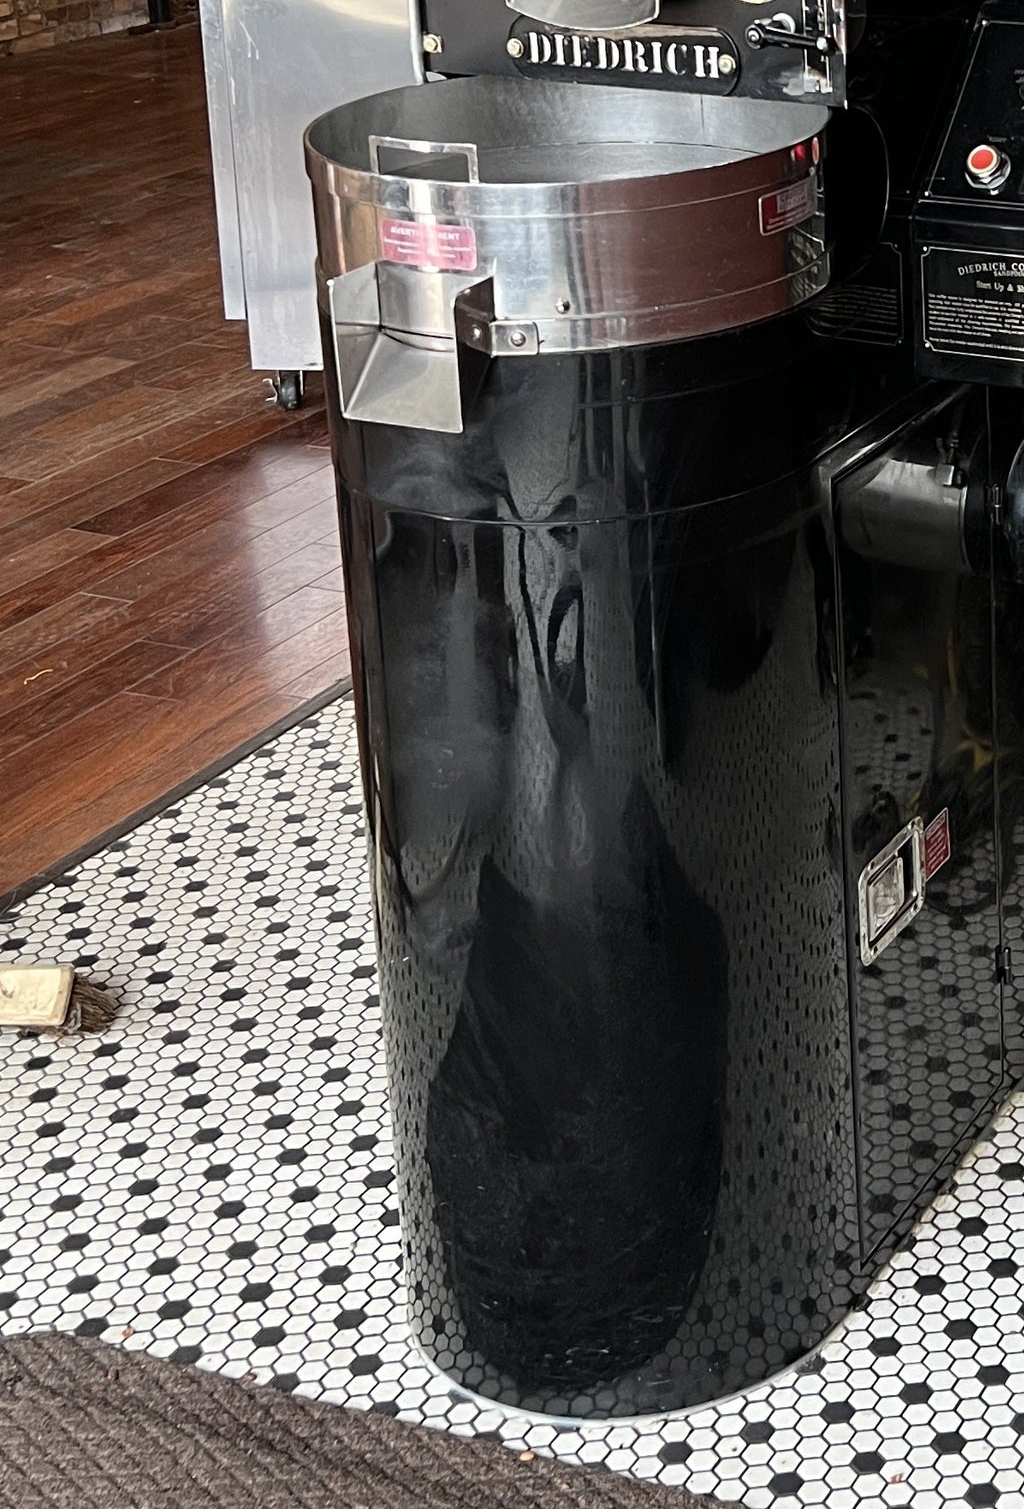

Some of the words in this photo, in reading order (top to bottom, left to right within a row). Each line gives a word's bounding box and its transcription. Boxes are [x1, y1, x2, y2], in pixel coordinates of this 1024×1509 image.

[527, 31, 720, 79] DIEDRICH
[957, 262, 1006, 276] DIEDRICH
[994, 282, 1004, 292] Up
[1007, 283, 1014, 292] &
